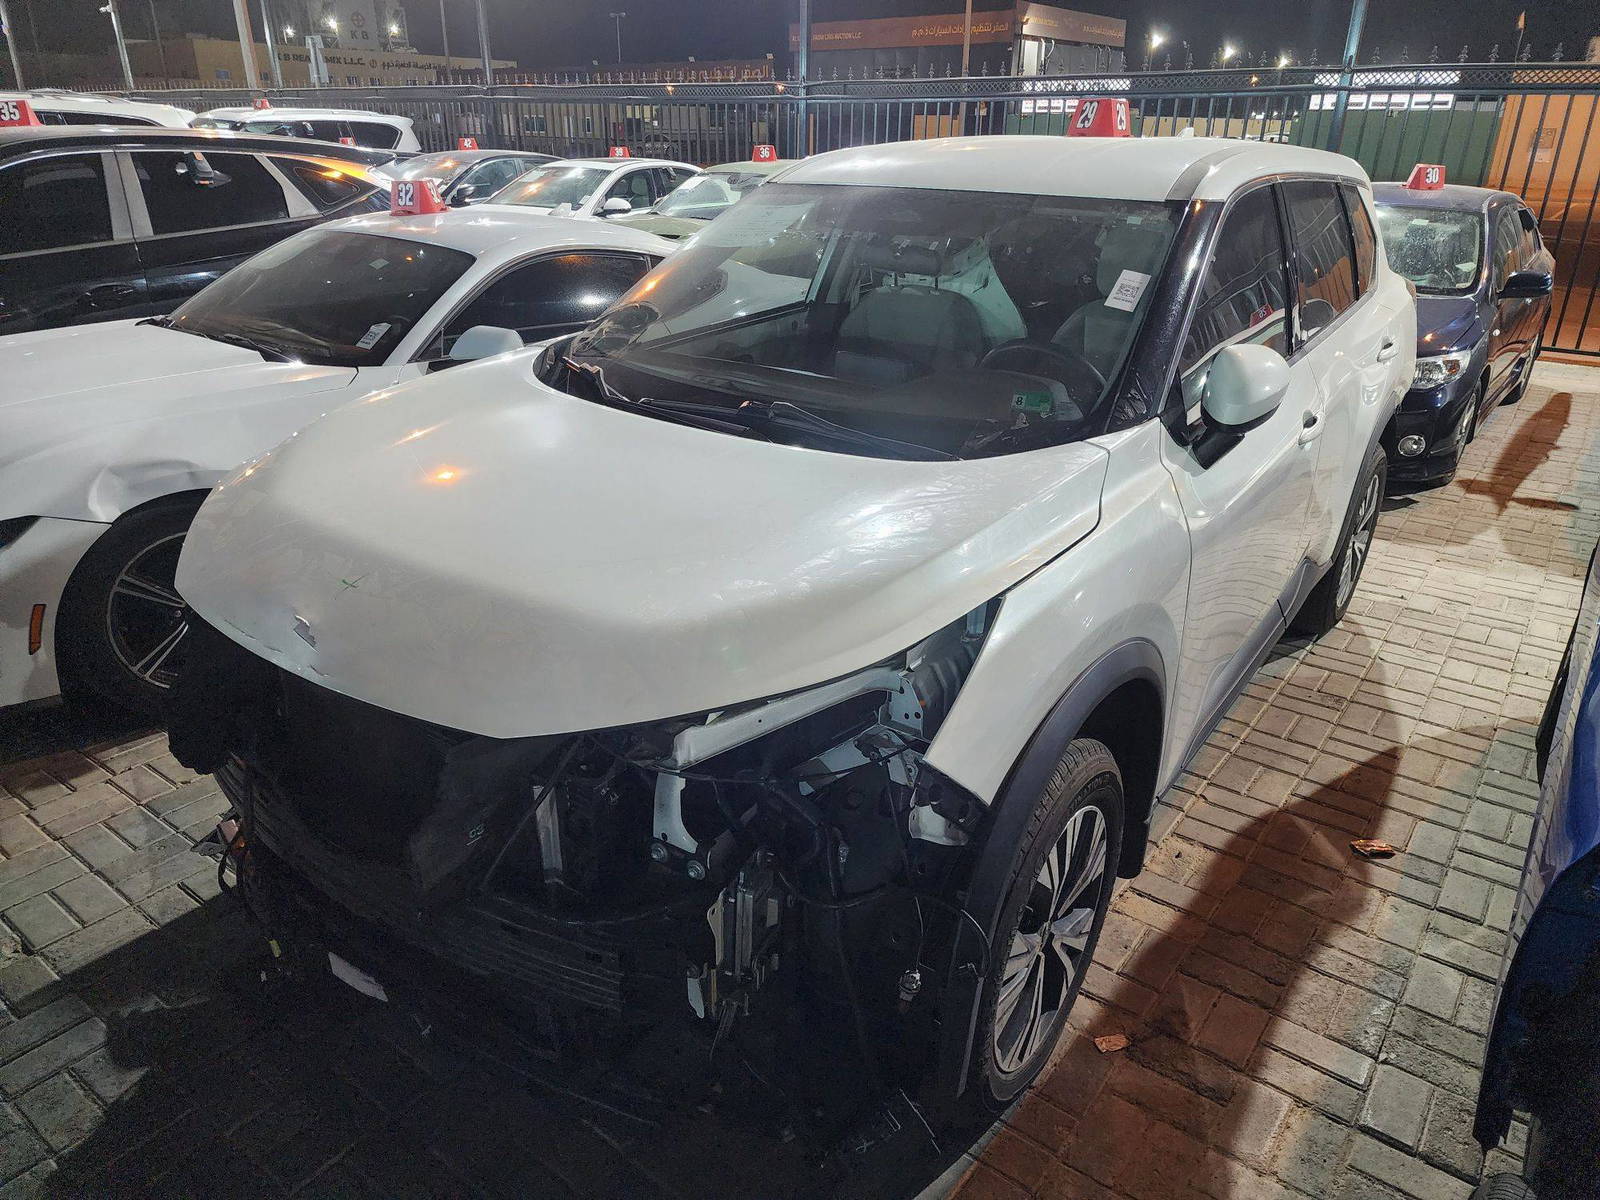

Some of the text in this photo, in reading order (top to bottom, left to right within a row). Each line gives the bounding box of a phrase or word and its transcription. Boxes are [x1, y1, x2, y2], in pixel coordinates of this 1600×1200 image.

[351, 30, 369, 40] K B
[0, 101, 20, 121] 35
[1076, 101, 1098, 128] 29
[759, 147, 770, 158] 36
[1425, 167, 1440, 184] 30
[398, 183, 414, 206] 32
